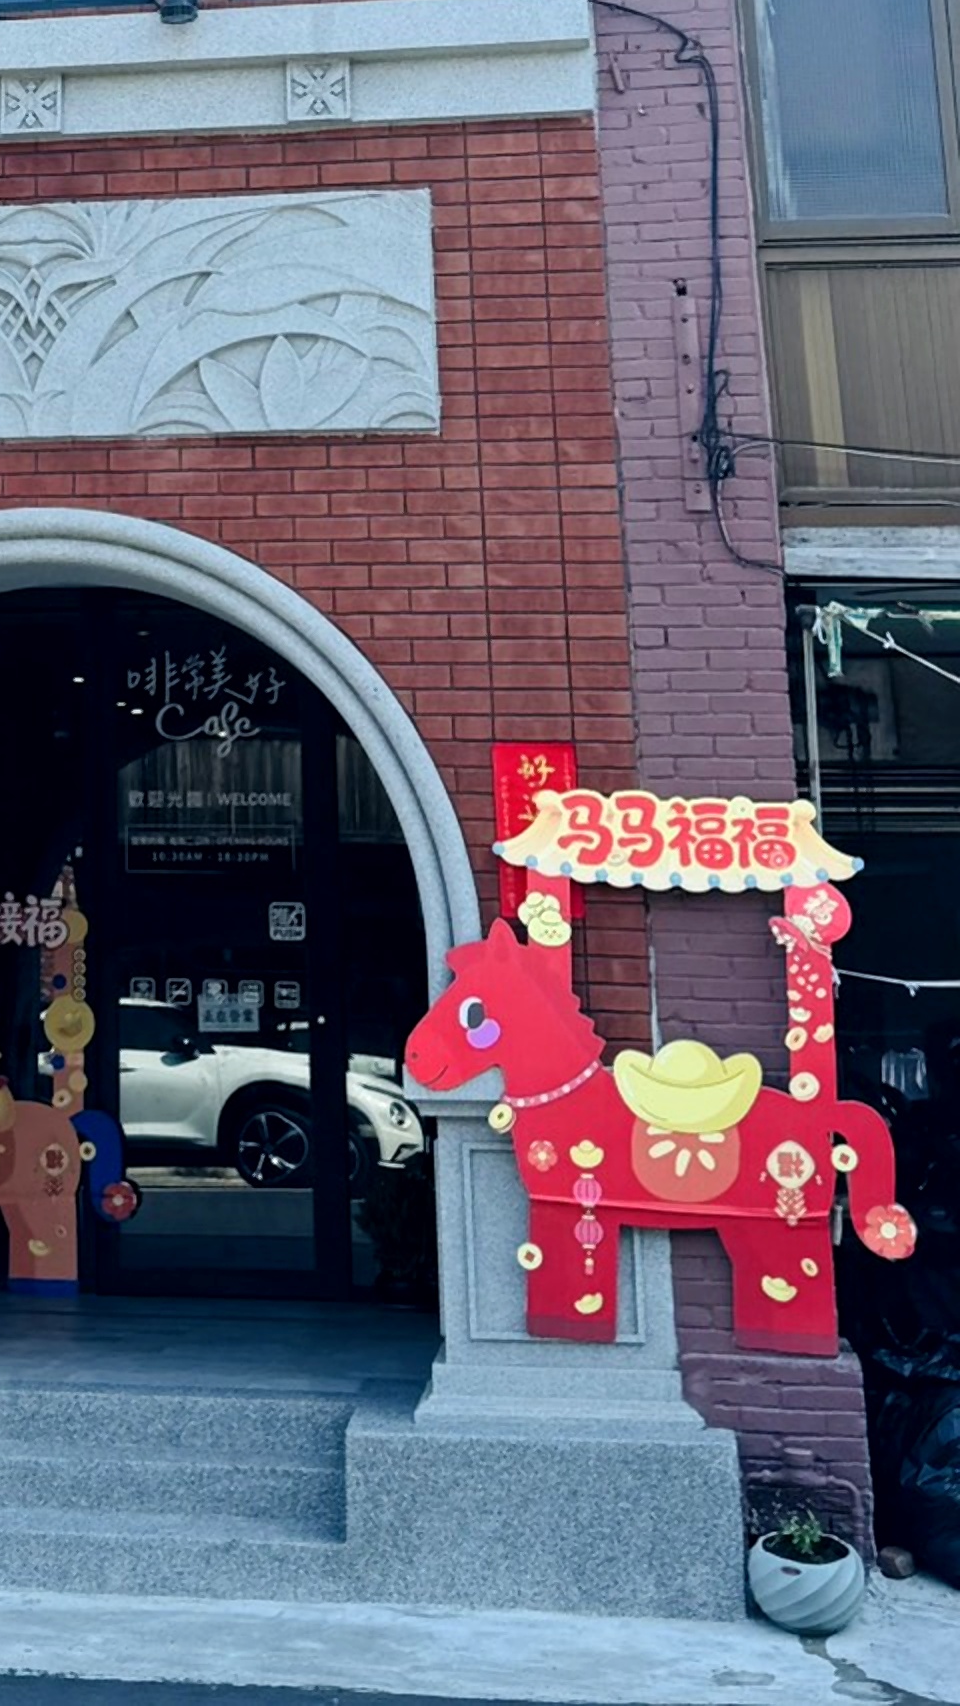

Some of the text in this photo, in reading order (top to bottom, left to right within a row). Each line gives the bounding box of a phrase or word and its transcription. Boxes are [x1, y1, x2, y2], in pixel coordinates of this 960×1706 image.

[126, 645, 287, 705] 啡常美好
[155, 702, 263, 758] Cafe
[216, 791, 292, 807] WELCOME
[557, 795, 796, 870] 马马福福
